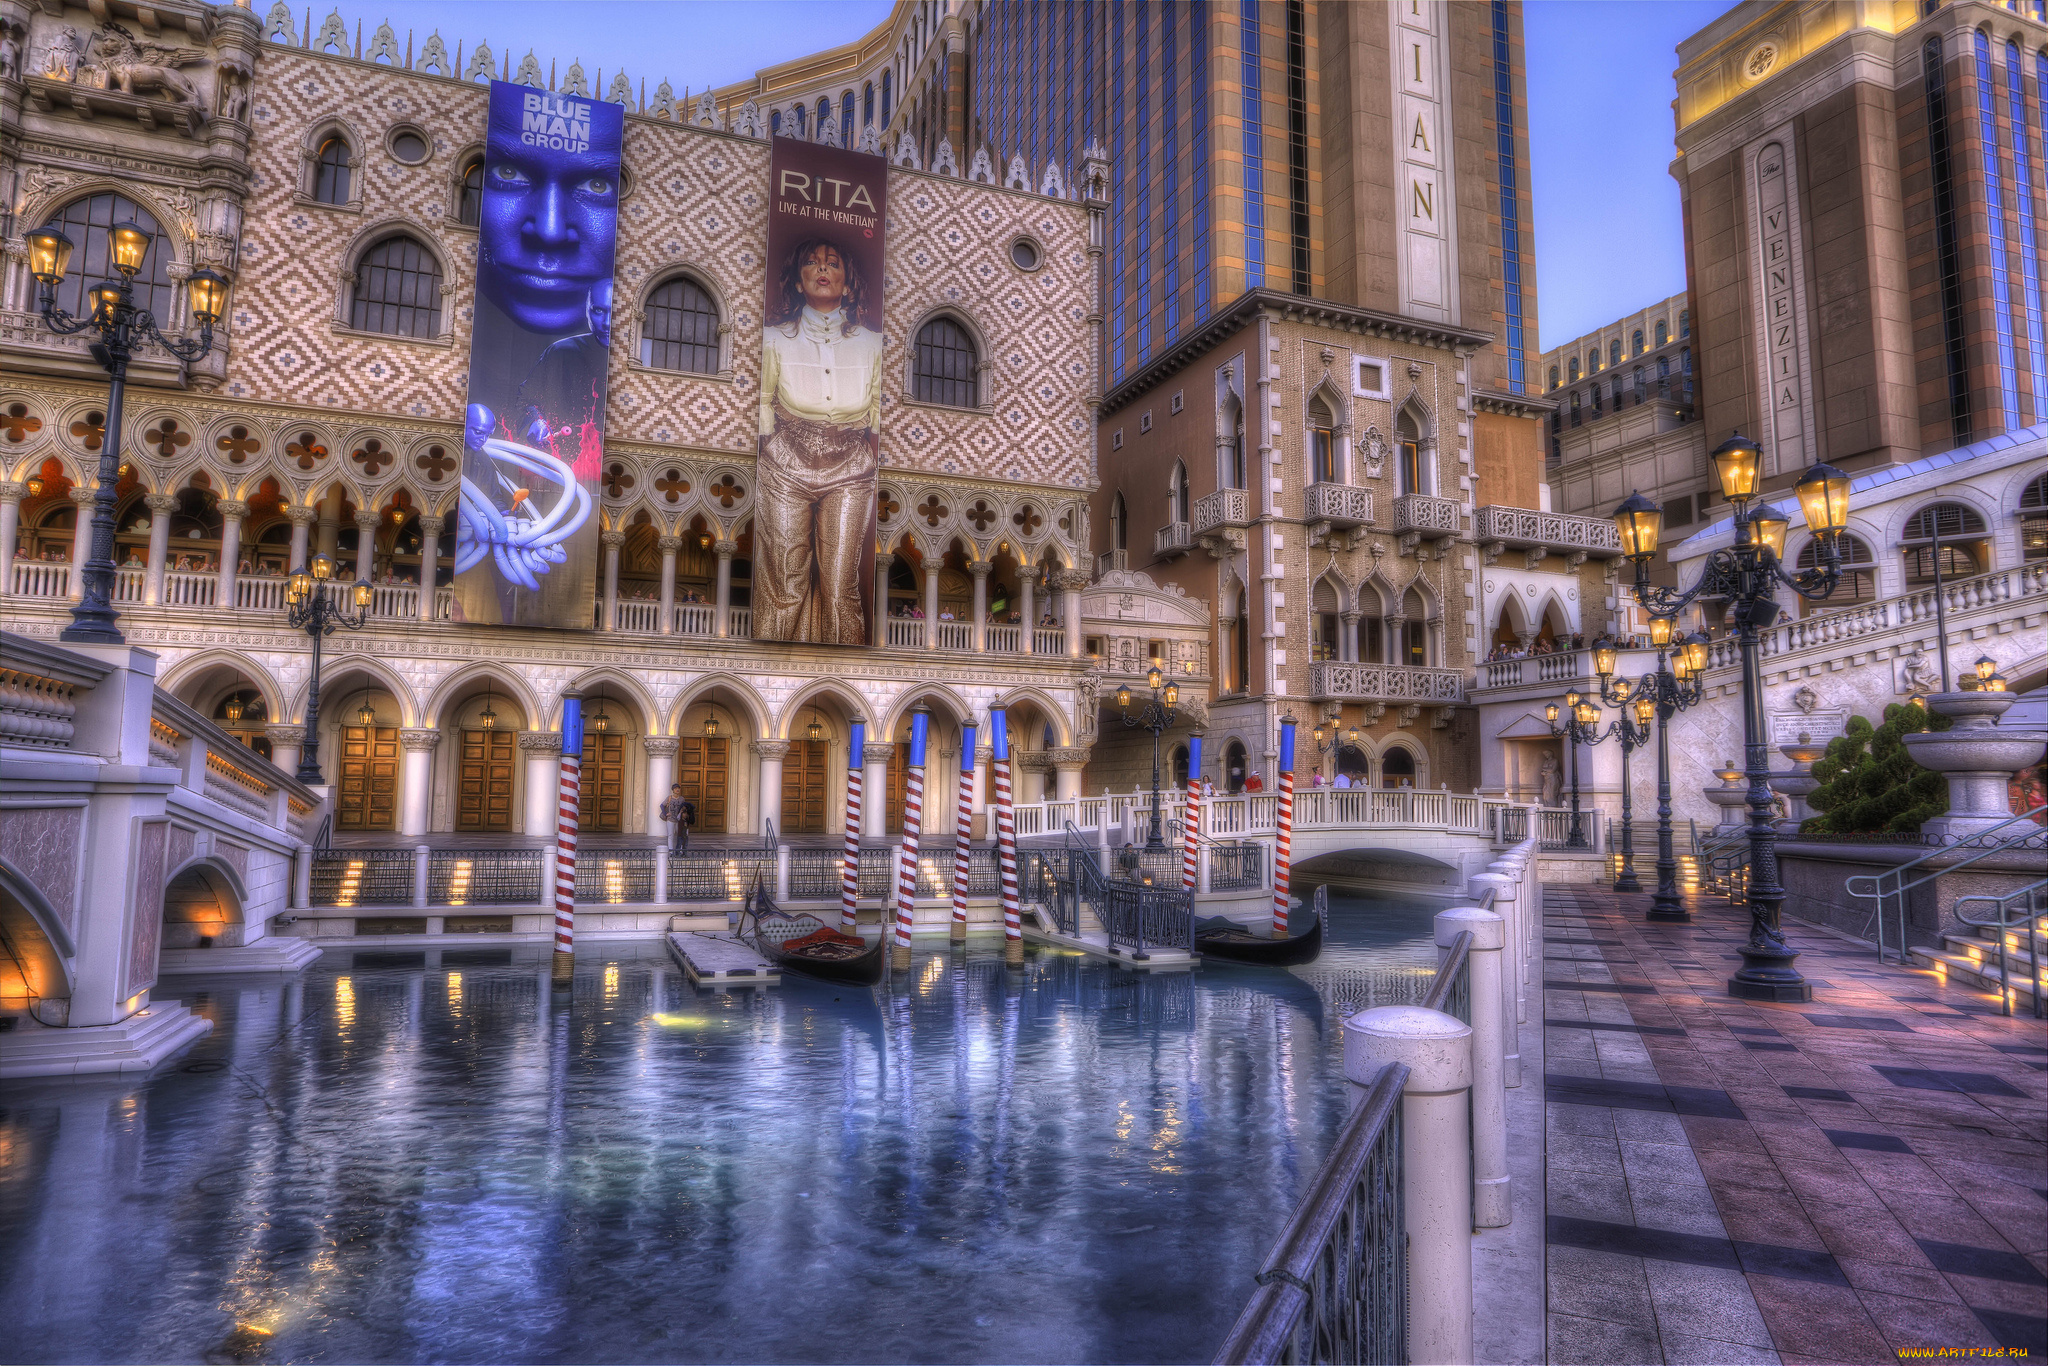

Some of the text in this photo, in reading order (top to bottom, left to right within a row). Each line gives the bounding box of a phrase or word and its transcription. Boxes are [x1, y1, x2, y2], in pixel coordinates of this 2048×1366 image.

[523, 92, 591, 122] BLUE
[522, 110, 591, 142] MAN
[520, 131, 590, 154] GROUP
[1762, 162, 1781, 178] The
[779, 200, 798, 215] LIVE
[799, 205, 812, 217] AT
[813, 207, 831, 221] THE
[1767, 210, 1795, 405] VENEZIA
